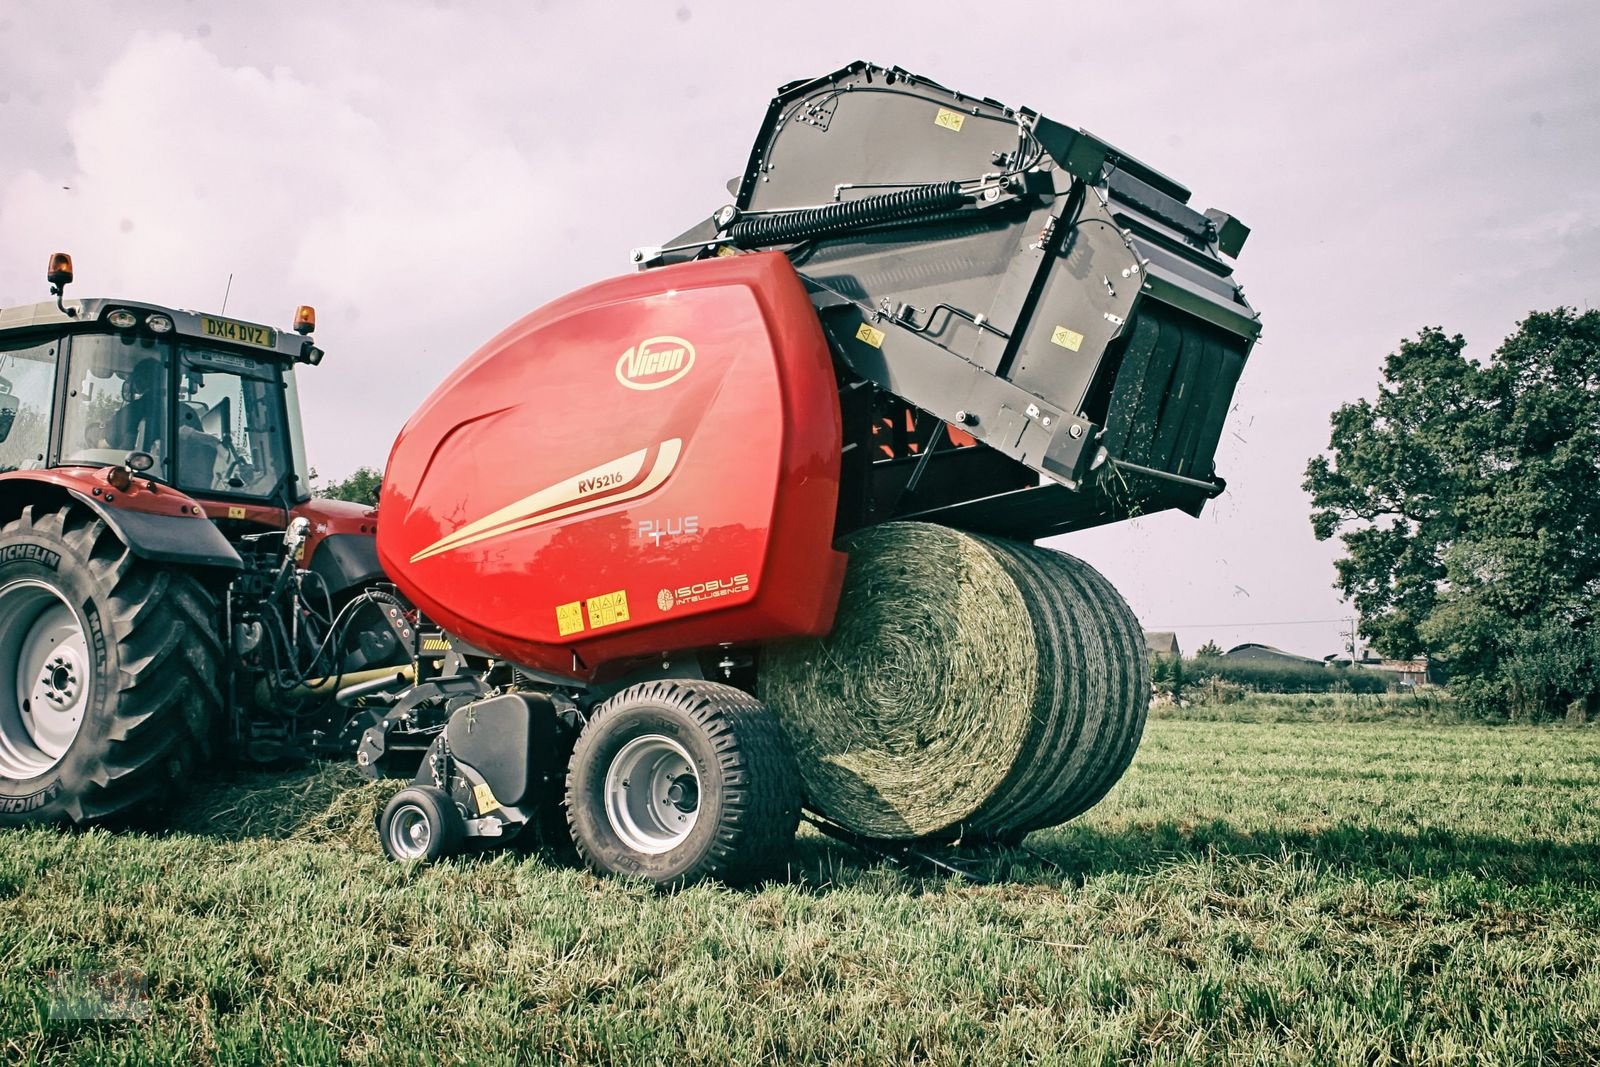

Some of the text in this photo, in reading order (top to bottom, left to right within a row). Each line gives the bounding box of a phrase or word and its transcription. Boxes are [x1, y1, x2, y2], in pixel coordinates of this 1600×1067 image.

[207, 319, 263, 344] DX14 DVZ
[624, 341, 687, 380] Vicon
[577, 471, 623, 494] RV5216
[638, 516, 699, 547] PLUS
[0, 544, 60, 567] ICHELIN
[674, 573, 749, 599] ISOBUS
[675, 584, 750, 606] INTELLIGENCE
